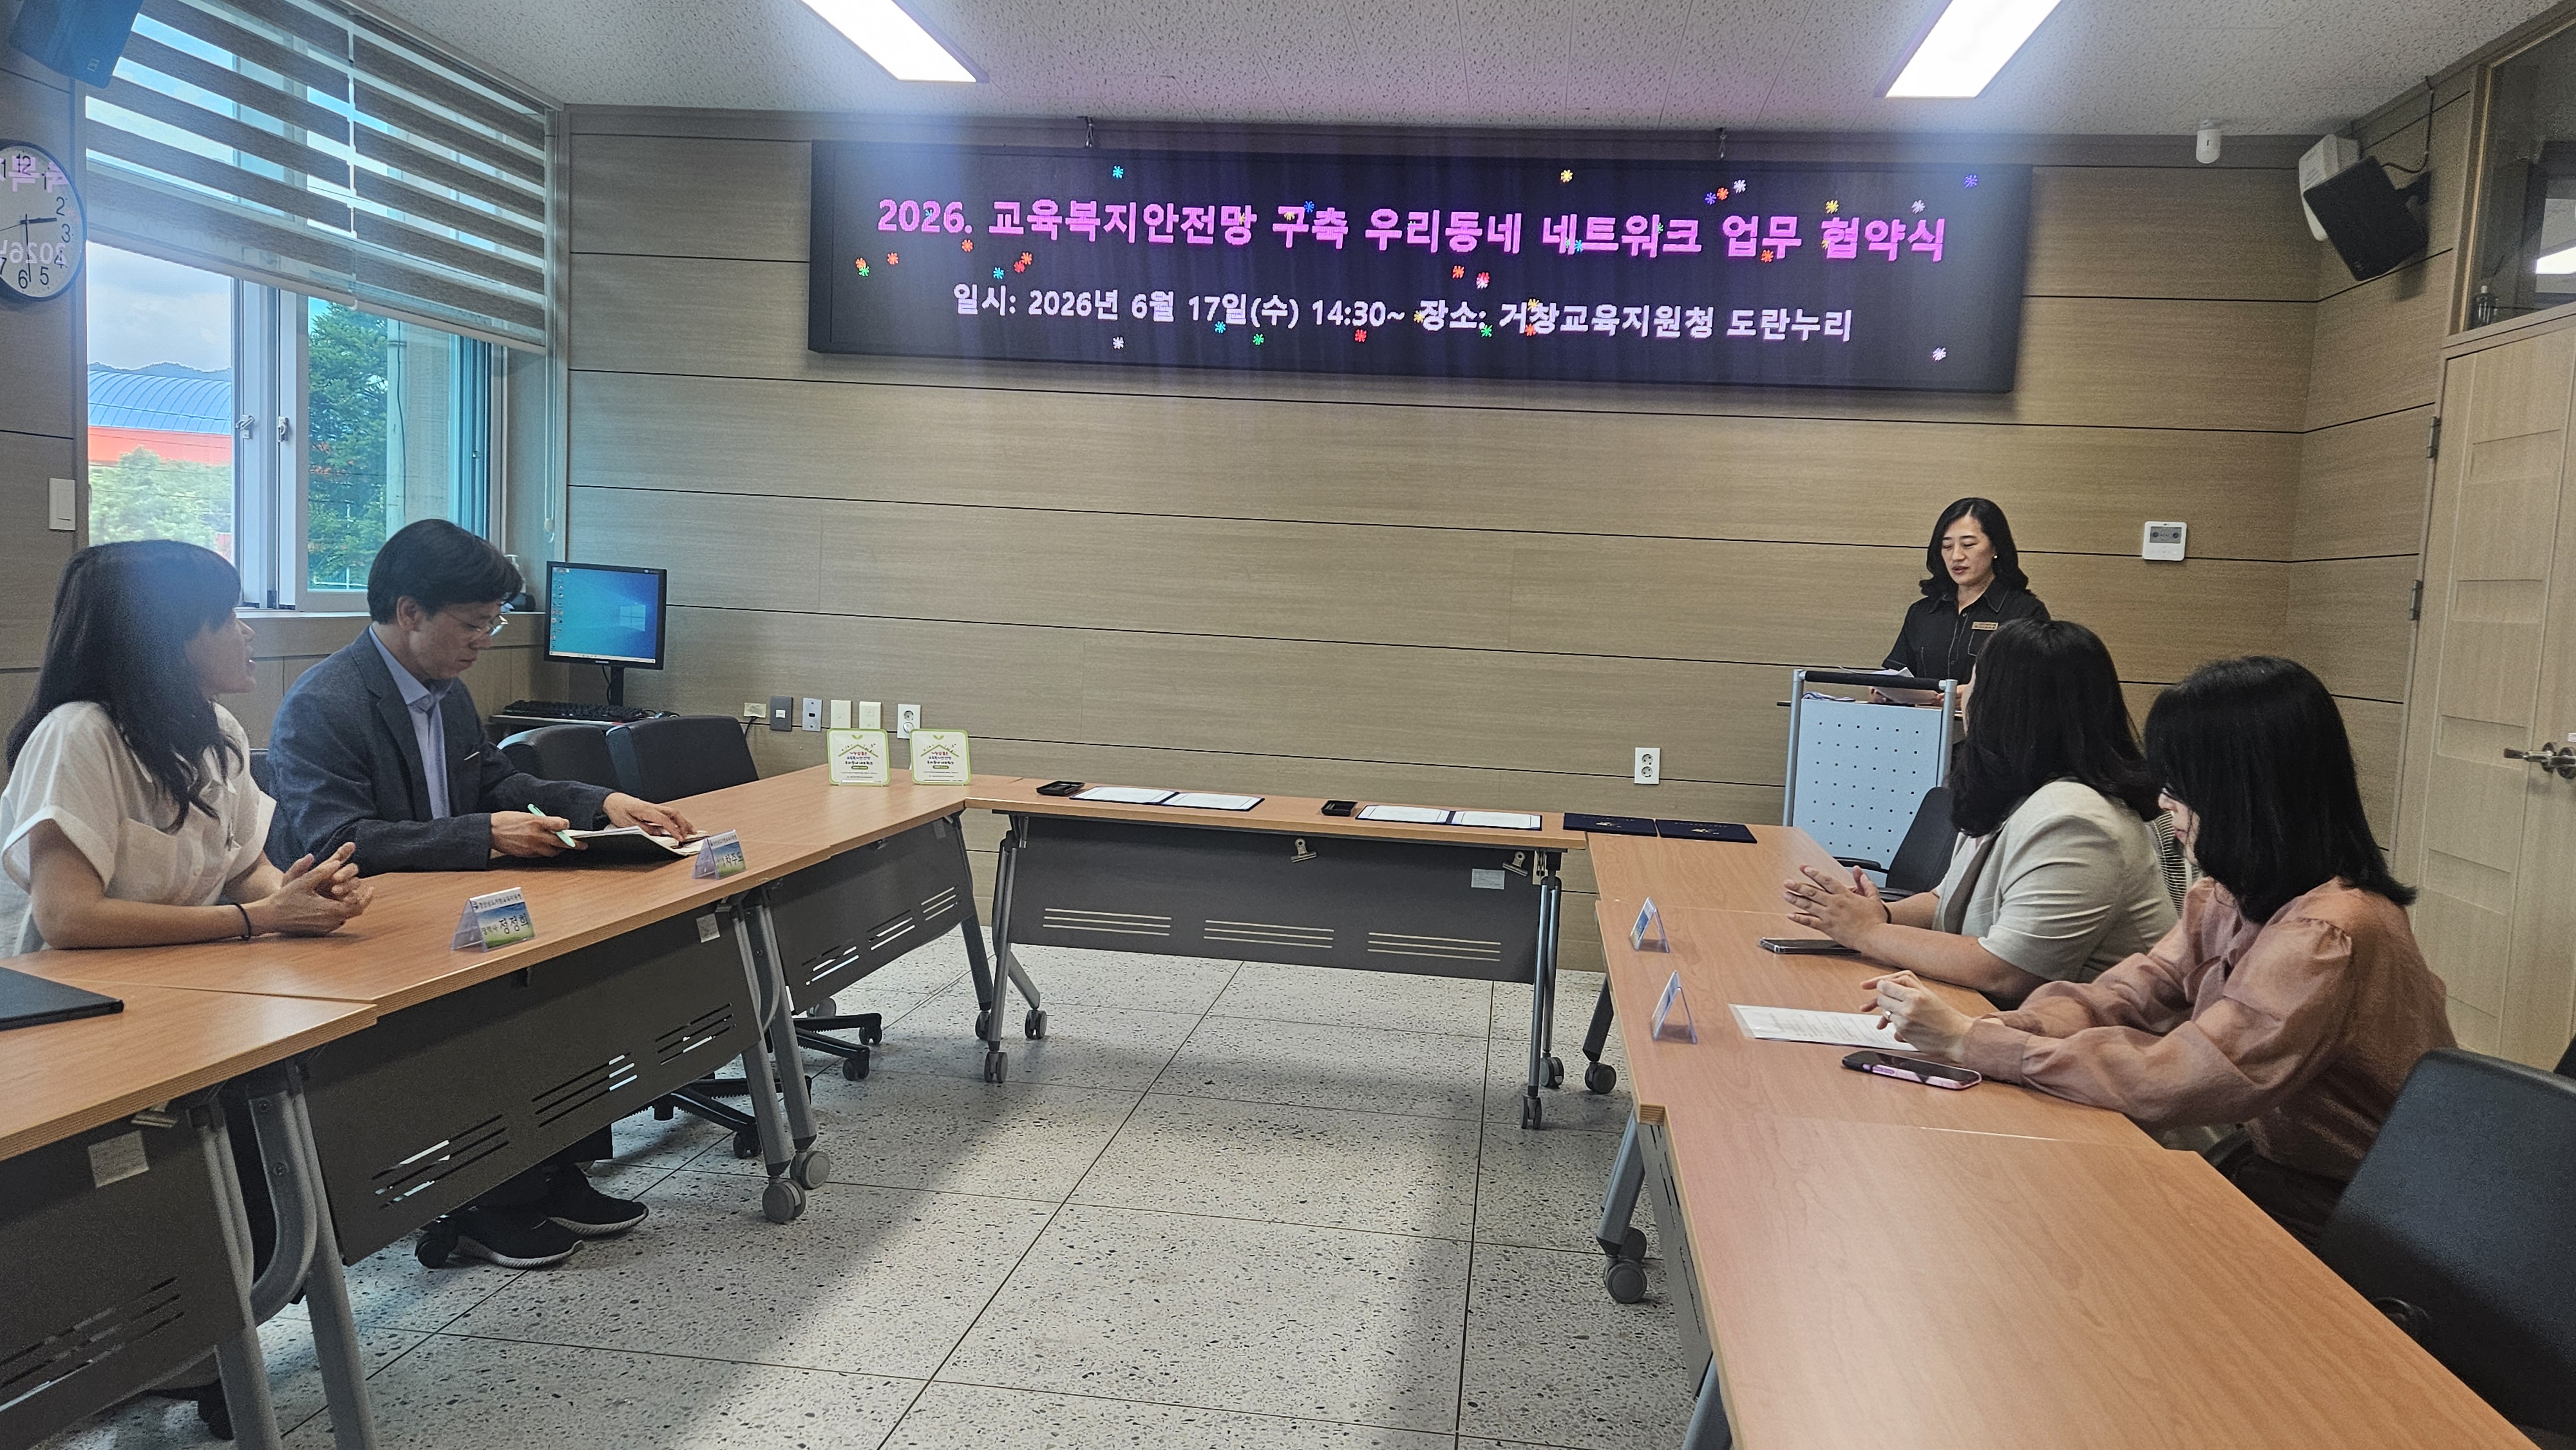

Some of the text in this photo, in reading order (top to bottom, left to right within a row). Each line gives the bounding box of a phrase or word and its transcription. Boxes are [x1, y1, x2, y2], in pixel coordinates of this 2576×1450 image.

[16, 153, 32, 176] 12
[55, 196, 65, 216] 2
[61, 223, 71, 243] 3
[877, 198, 1946, 263] 2026. 교육복지안전망 구축 우리동네 네트워크 업무 협약식
[18, 269, 28, 289] 6
[39, 266, 49, 285] 5
[953, 283, 1852, 343] 일시: 2026년 6월 17일(수) 14:30~ 장소: 거창교육지원청 도란누리
